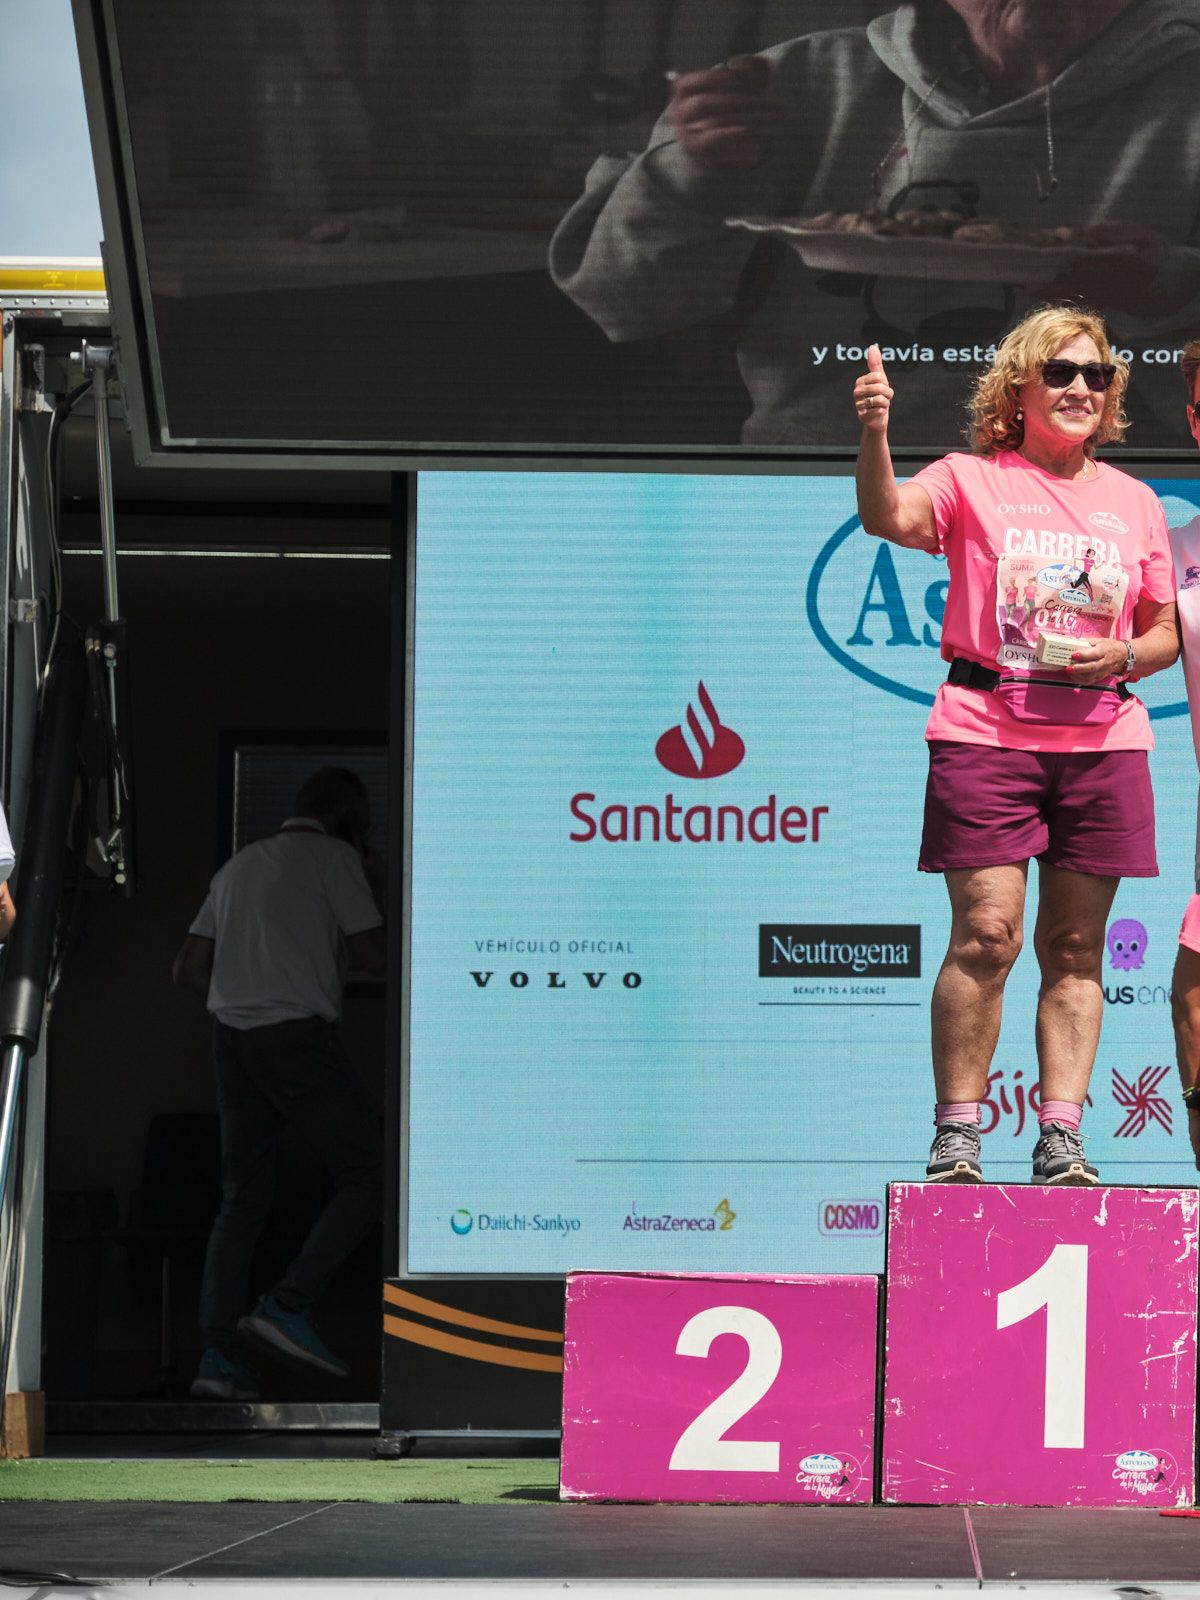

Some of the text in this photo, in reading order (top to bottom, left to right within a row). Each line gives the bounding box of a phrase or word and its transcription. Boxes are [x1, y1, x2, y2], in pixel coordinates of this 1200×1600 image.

[812, 346, 828, 366] y
[836, 343, 934, 362] toavía
[998, 503, 1051, 516] OYSHO
[569, 793, 829, 843] Santander
[475, 938, 634, 954] VEHÍCULO OFICIAL
[771, 935, 910, 972] Neutrogena
[470, 970, 643, 990] VOLVO
[478, 1213, 581, 1237] Daiichi-Sankyo
[623, 1214, 716, 1232] AstraZeneca
[824, 1205, 880, 1231] COSMO
[997, 1243, 1089, 1449] 1
[668, 1305, 783, 1471] 2
[796, 1472, 831, 1483] Carrera
[1112, 1468, 1147, 1479] Carrera
[815, 1483, 843, 1499] Mujer
[1131, 1480, 1159, 1495] Mujer
